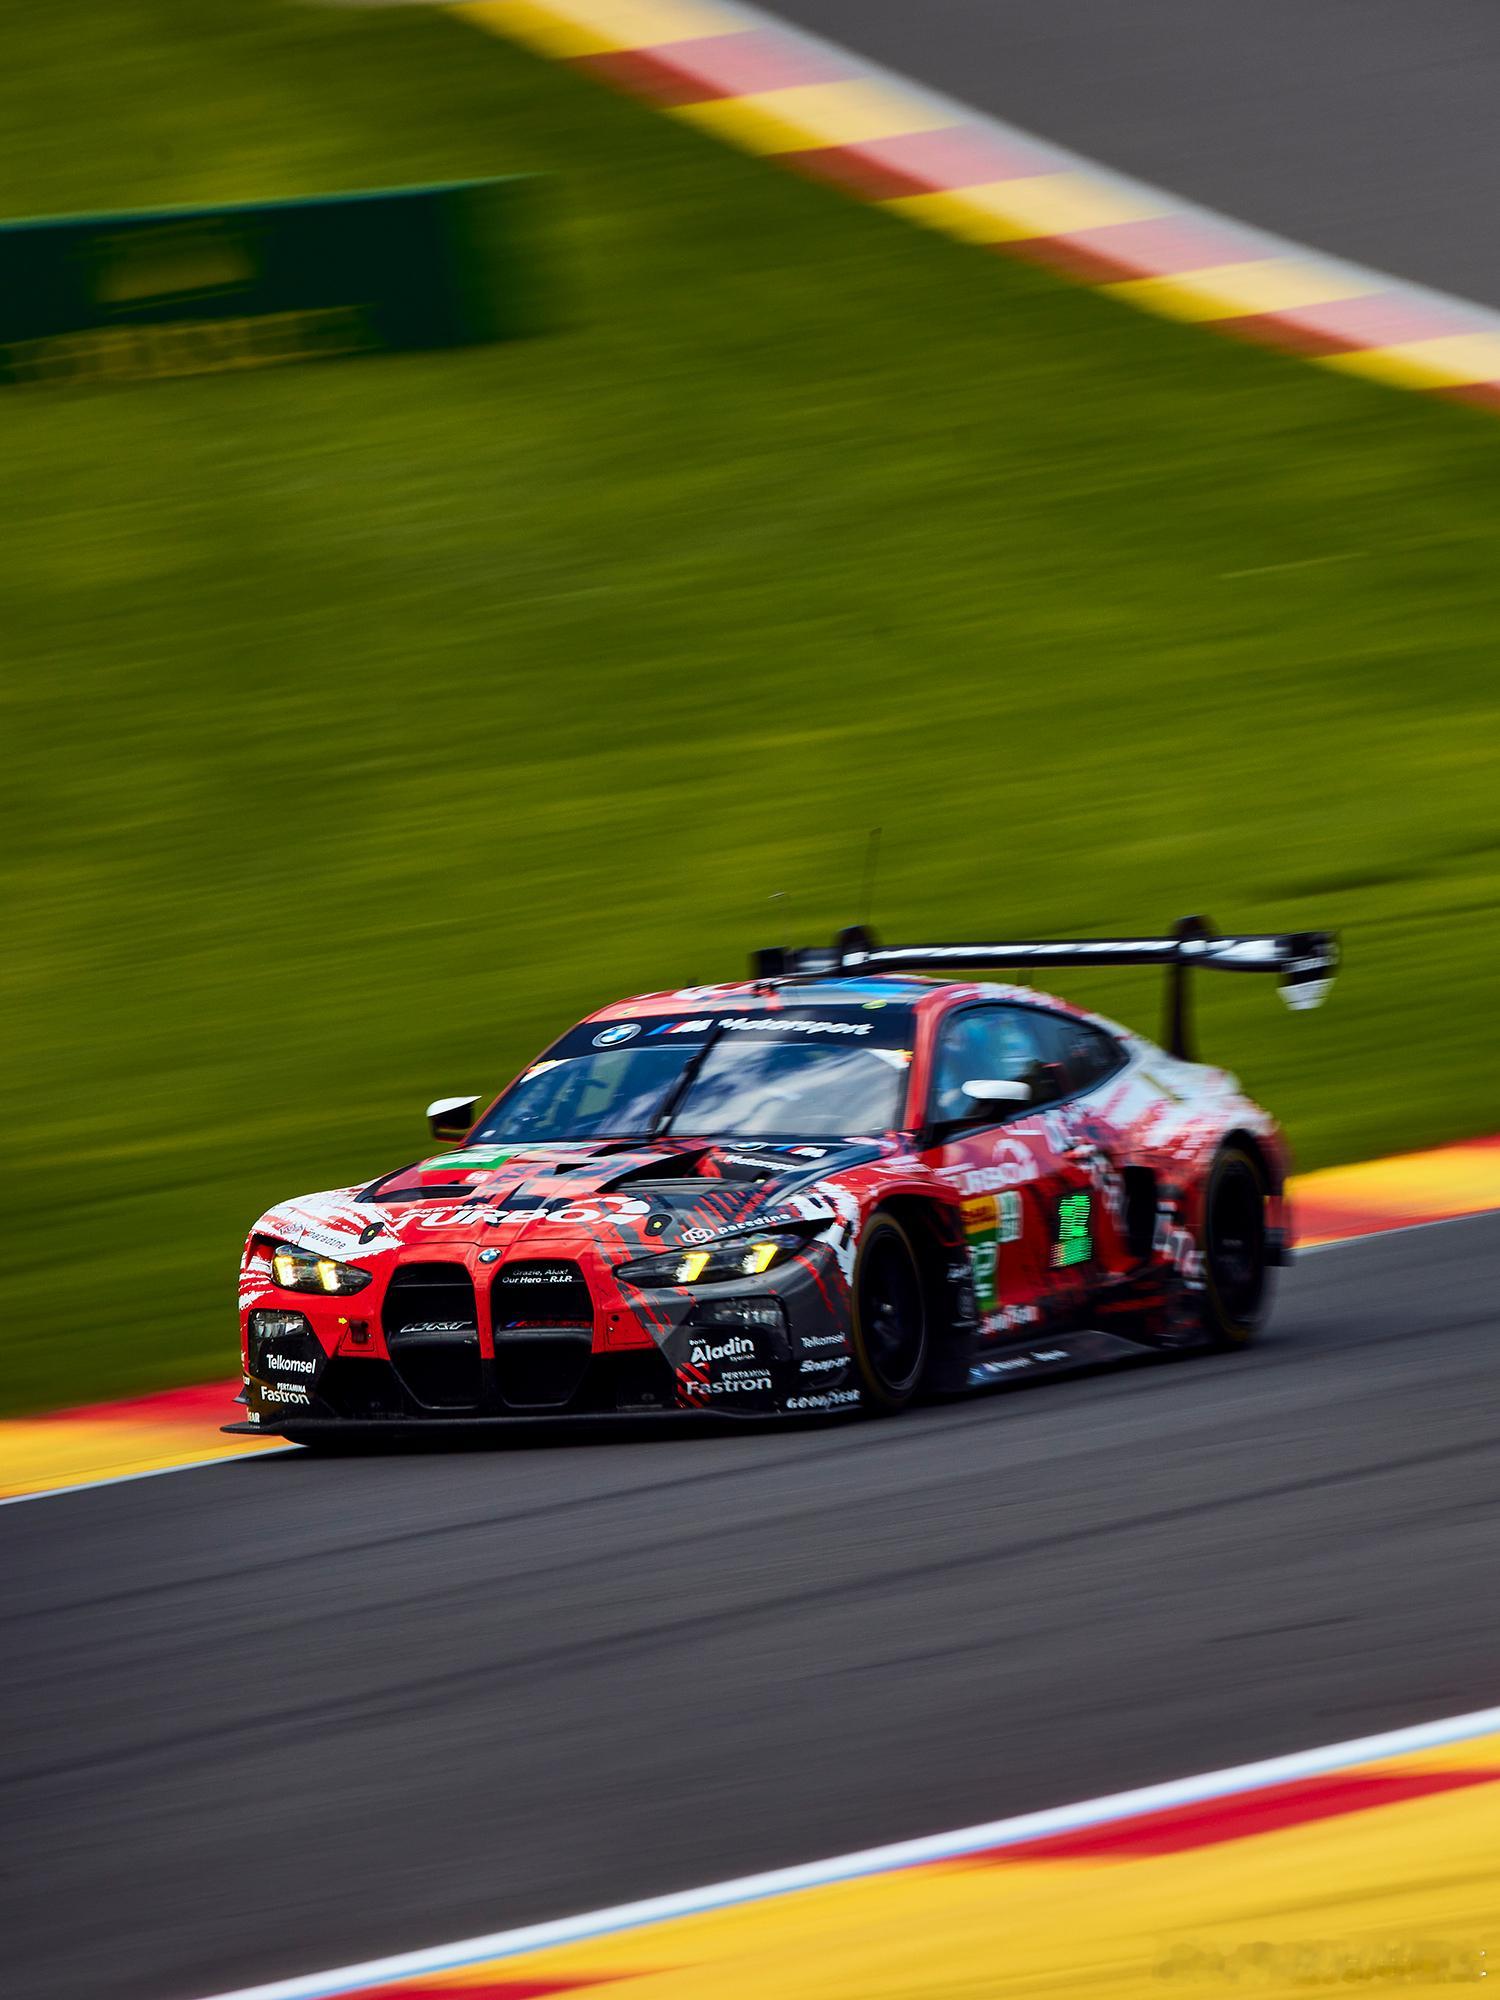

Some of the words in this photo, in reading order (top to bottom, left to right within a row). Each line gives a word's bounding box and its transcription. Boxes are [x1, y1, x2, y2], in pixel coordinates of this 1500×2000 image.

[717, 1017, 875, 1036] Motorsport
[502, 1276, 520, 1284] Our
[520, 1275, 542, 1284] Hero
[691, 1336, 755, 1364] Aladin
[266, 1353, 318, 1375] Telkomsel
[260, 1385, 311, 1406] Fastron
[686, 1376, 773, 1396] Fastron
